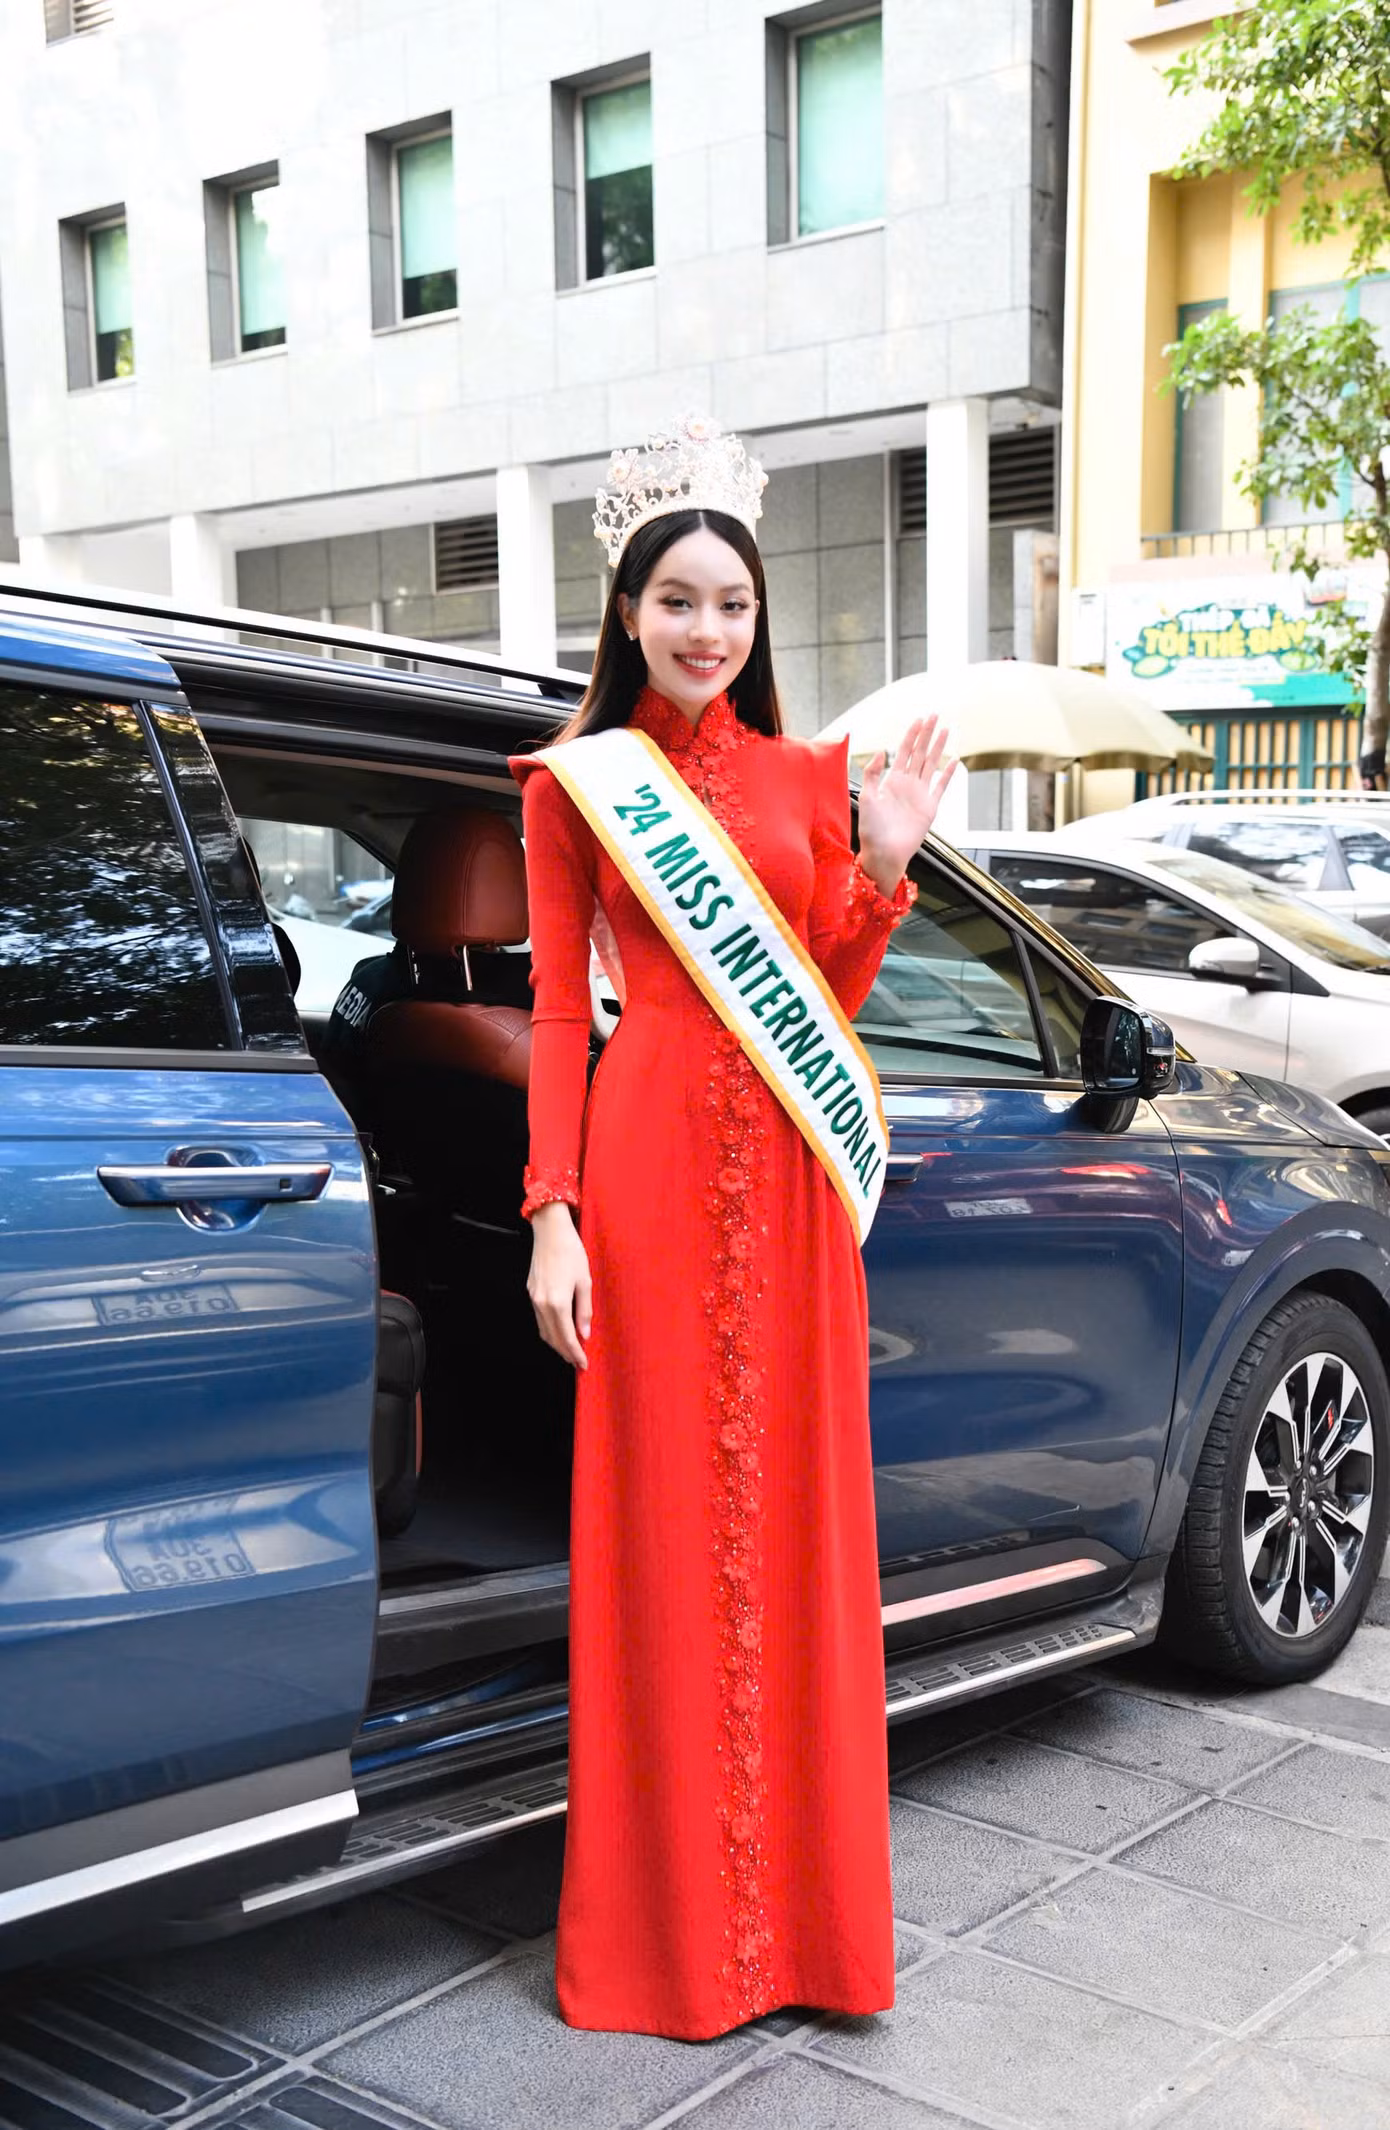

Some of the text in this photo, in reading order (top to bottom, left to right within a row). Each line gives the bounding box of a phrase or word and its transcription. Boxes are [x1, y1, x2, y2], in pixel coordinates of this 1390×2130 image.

[613, 784, 882, 1198] '24 MISS INTERNATIONAL
